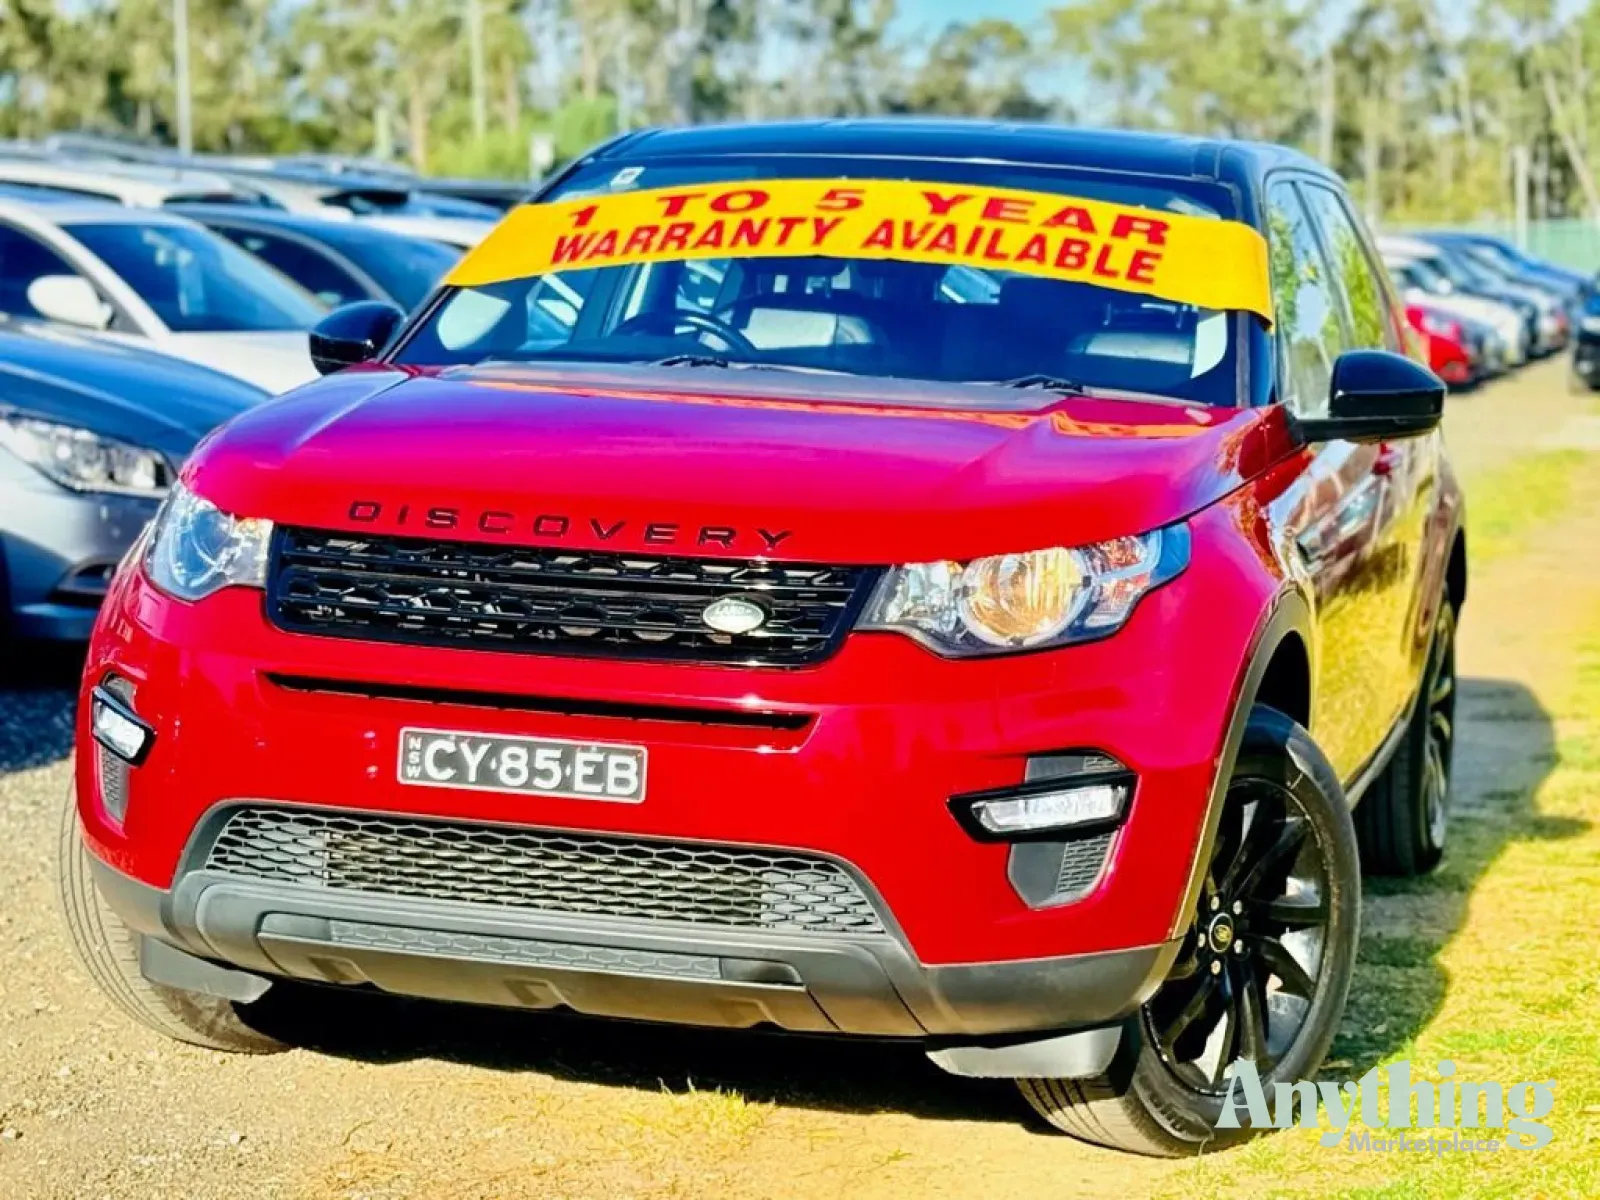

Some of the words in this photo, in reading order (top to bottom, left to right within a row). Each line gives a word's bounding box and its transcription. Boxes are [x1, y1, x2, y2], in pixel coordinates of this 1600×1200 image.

[569, 205, 598, 228] 1
[657, 190, 770, 217] TO
[815, 189, 865, 212] 5
[921, 191, 1170, 246] YEAR
[550, 217, 844, 264] WARRANTY
[861, 219, 1162, 284] AVAILABLE
[348, 499, 794, 552] DISCOVERY
[405, 736, 423, 779] NSW
